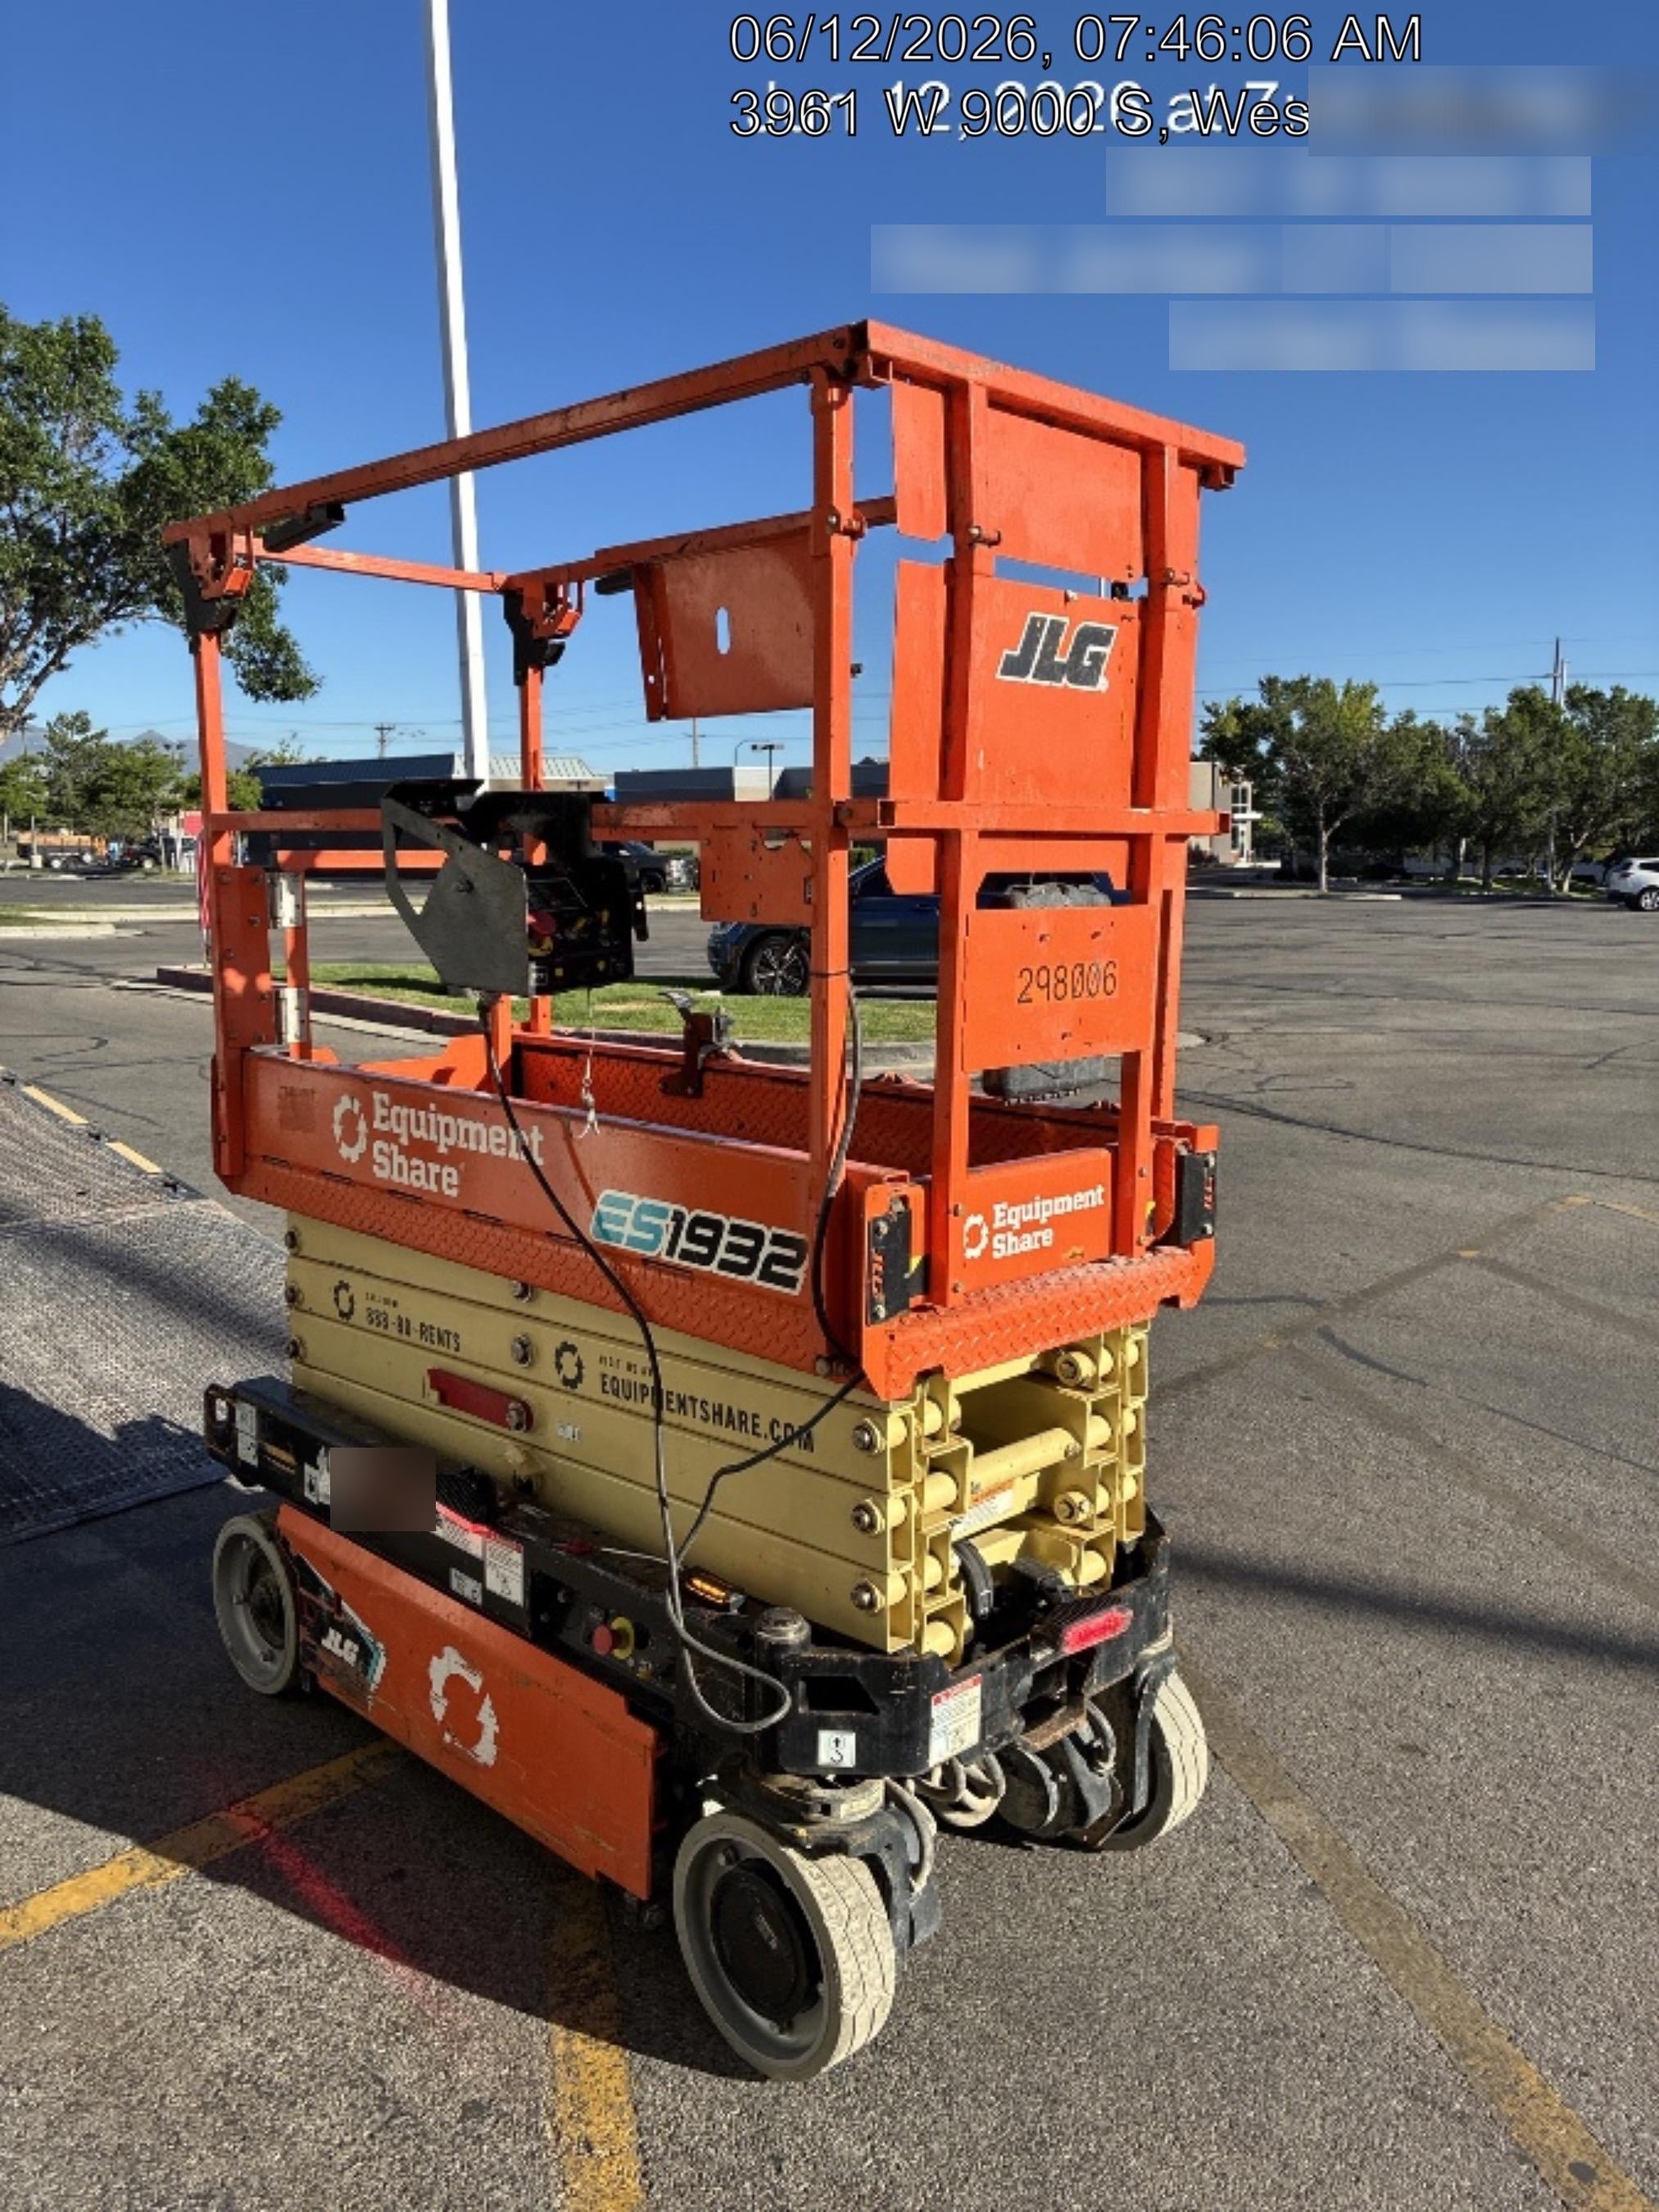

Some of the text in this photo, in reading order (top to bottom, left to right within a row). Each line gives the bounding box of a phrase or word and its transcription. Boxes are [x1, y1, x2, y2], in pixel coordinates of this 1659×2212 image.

[995, 612, 1118, 691] JLG
[1018, 960, 1117, 1004] 298006
[373, 1090, 544, 1166] Equipment
[373, 1140, 459, 1197] Share
[993, 1184, 1104, 1230] Equipment
[591, 1189, 809, 1294] ES1932
[993, 1228, 1054, 1258] Share
